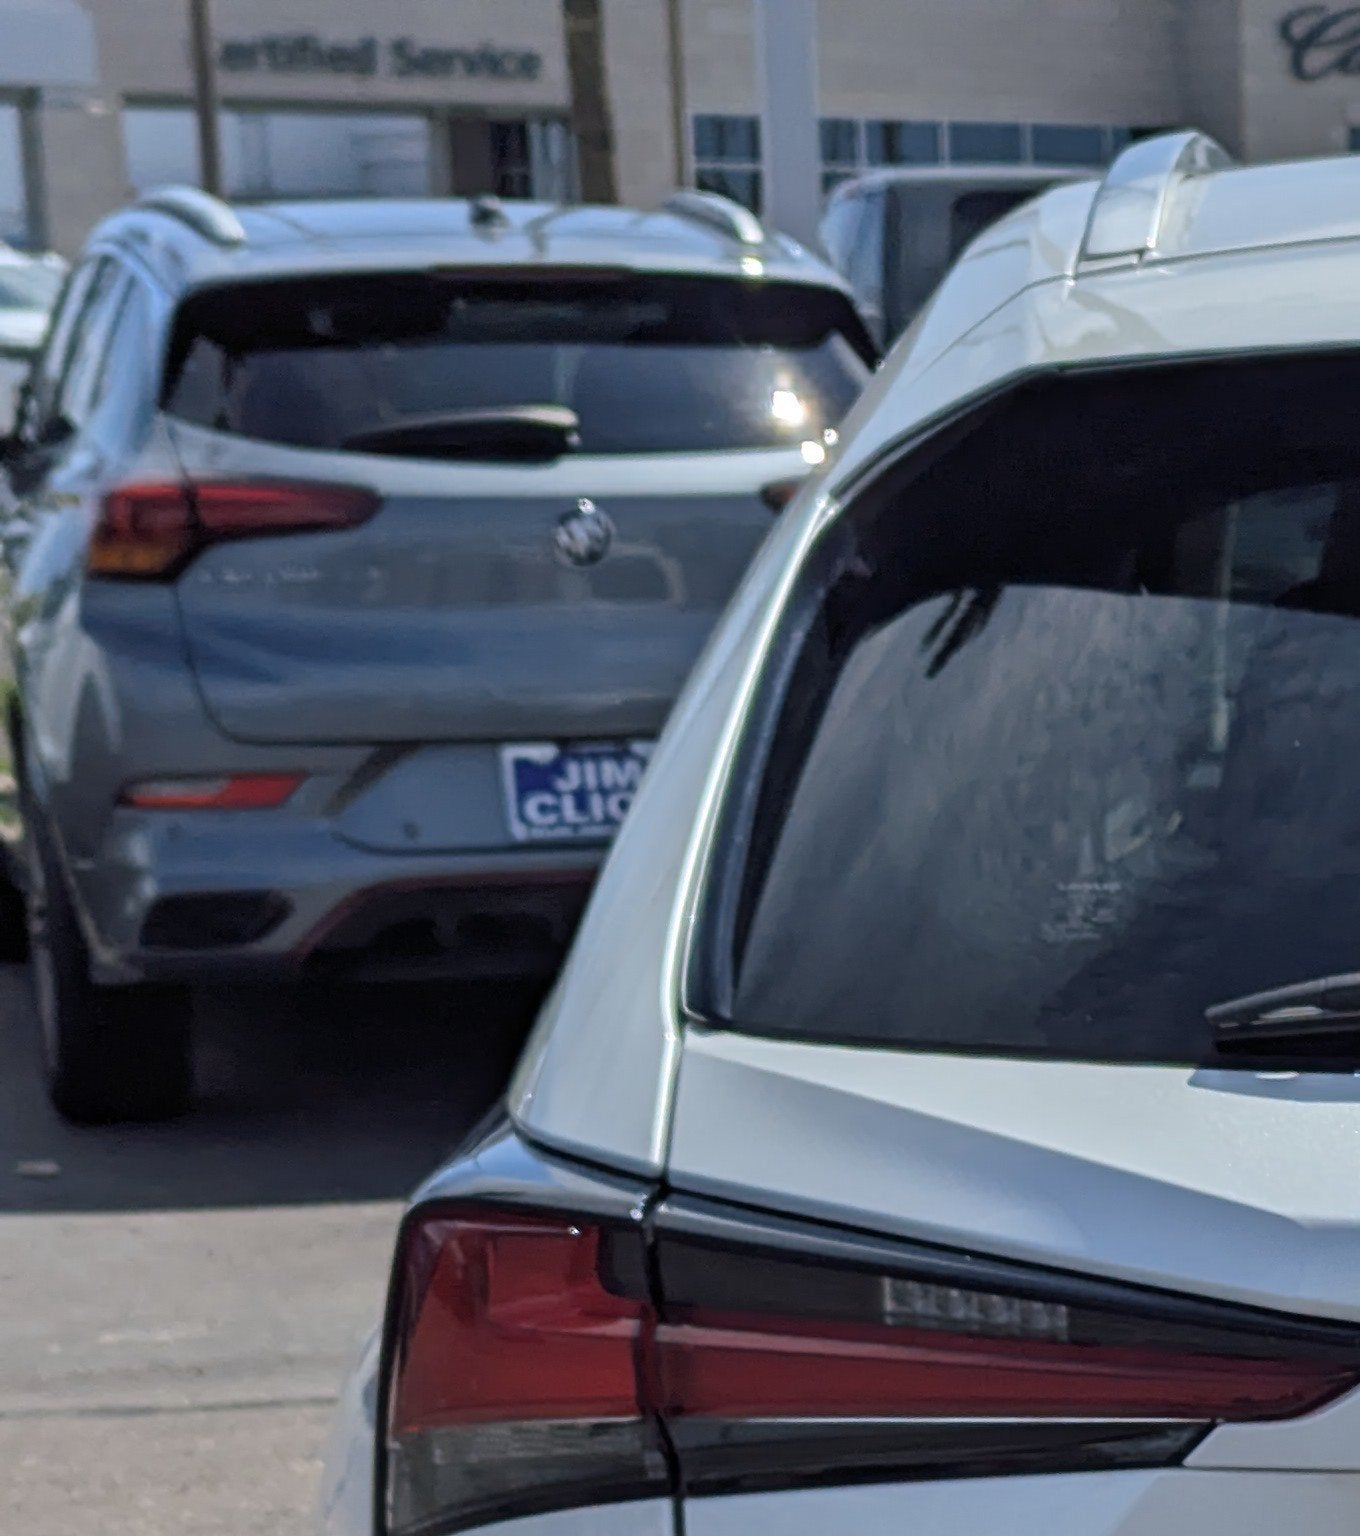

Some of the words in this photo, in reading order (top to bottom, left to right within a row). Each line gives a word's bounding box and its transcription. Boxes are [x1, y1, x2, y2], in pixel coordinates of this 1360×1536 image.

[219, 35, 379, 76] ertified
[391, 36, 543, 80] Service
[554, 759, 641, 792] JIM
[524, 792, 634, 825] CLIC
